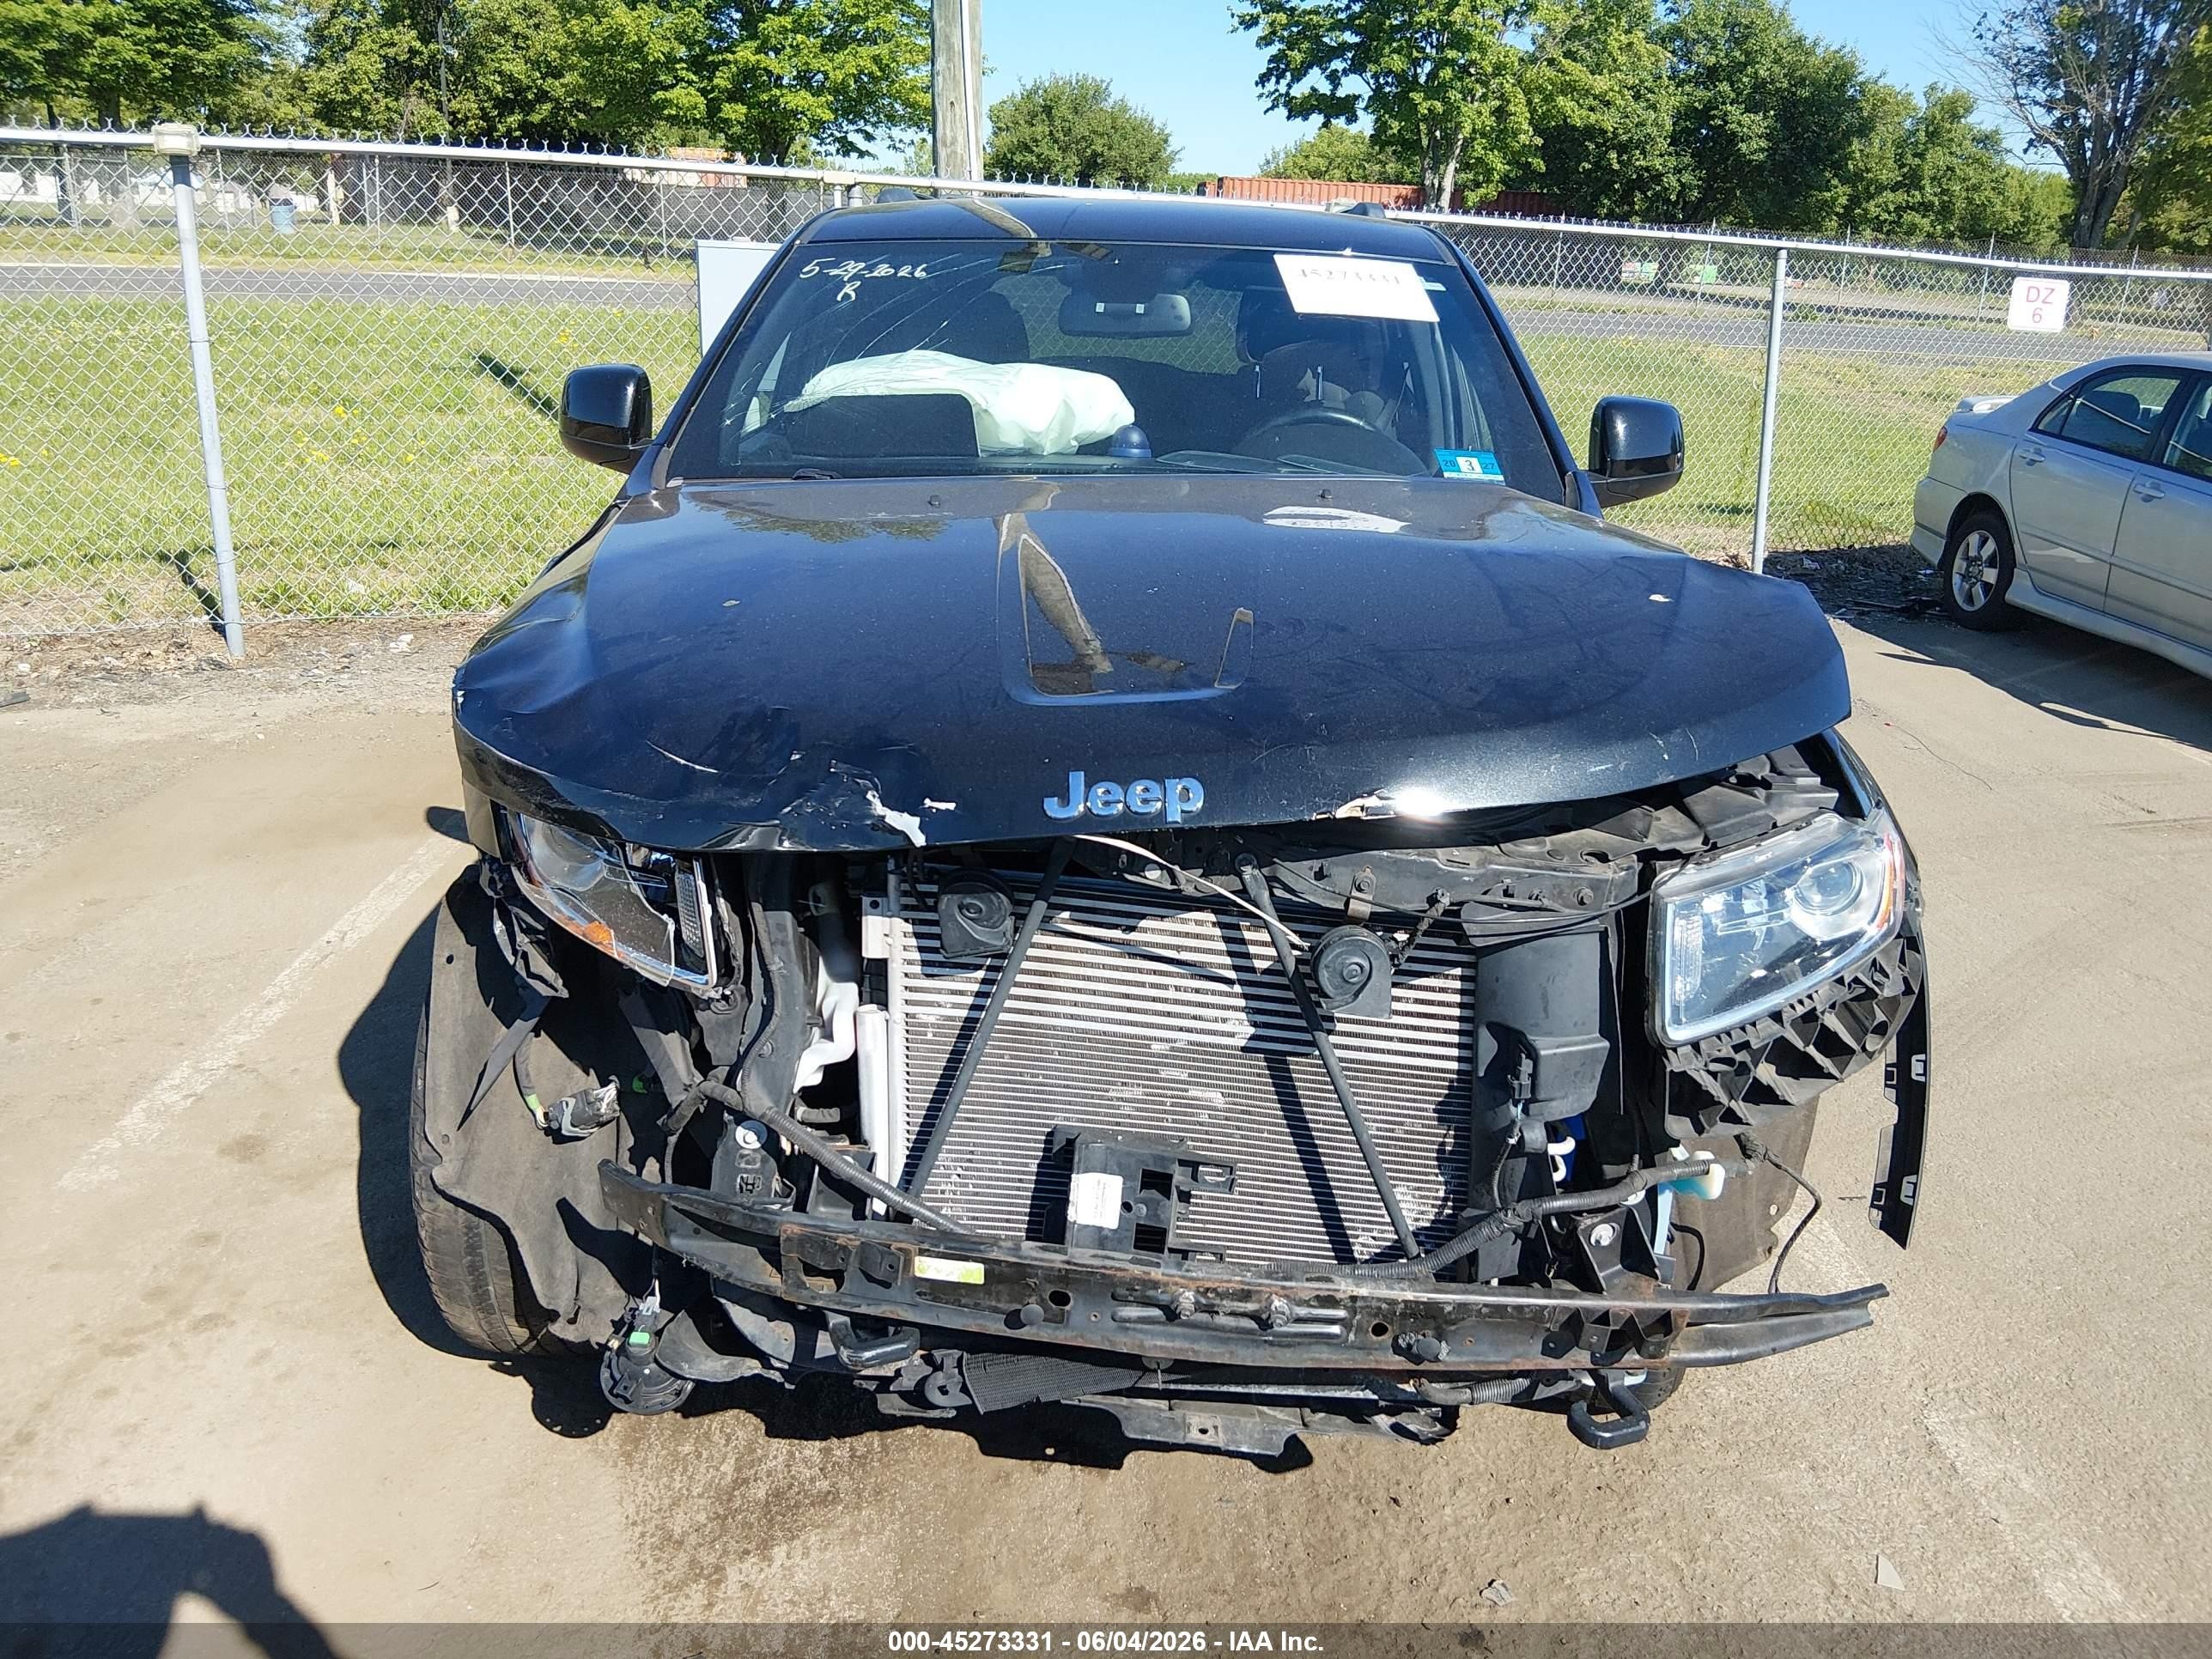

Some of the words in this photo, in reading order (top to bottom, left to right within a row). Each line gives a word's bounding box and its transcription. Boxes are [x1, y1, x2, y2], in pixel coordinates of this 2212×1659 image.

[799, 258, 927, 281] 5-29-2026
[2026, 285, 2056, 305] DZ
[2032, 307, 2043, 324] 6
[1464, 459, 1475, 471] 3
[1042, 769, 1206, 824] Jeep
